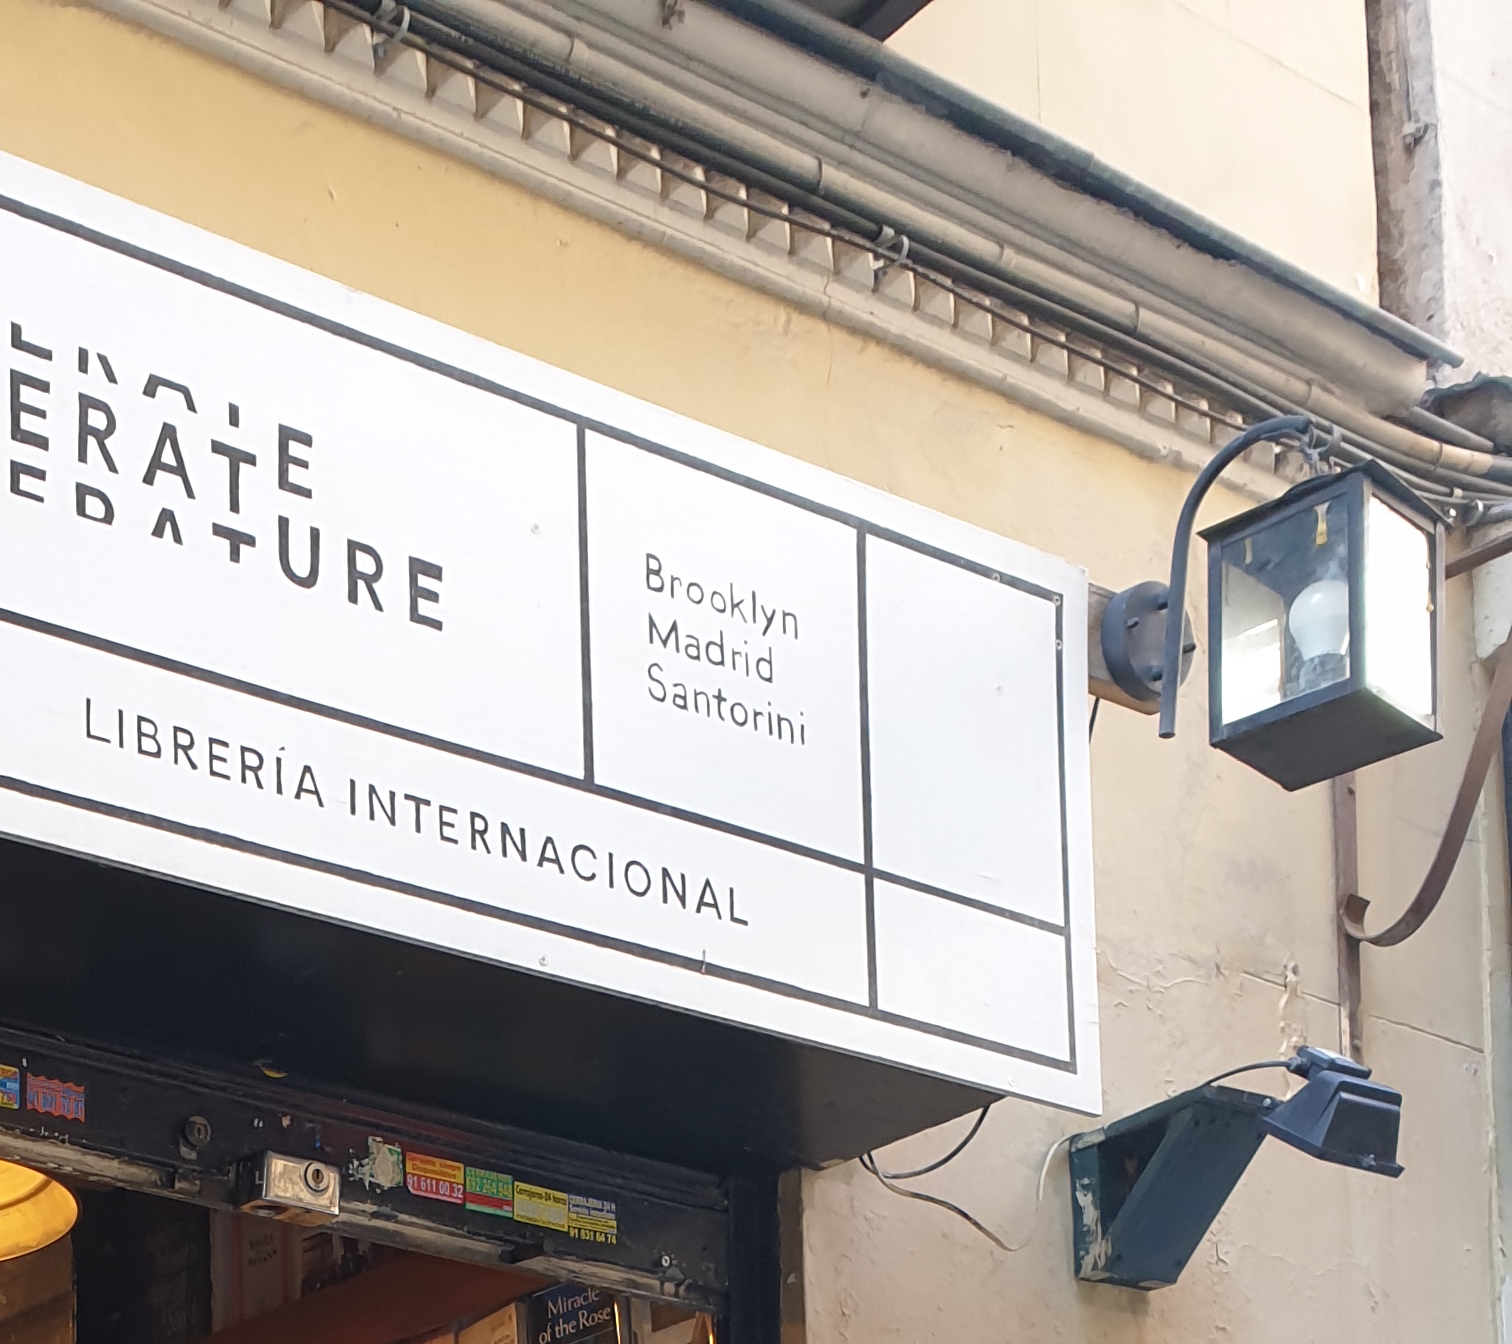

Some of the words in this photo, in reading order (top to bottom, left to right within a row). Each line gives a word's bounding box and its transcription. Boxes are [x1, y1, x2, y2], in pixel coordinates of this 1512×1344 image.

[644, 552, 800, 641] Brooklyn
[646, 612, 774, 684] Madrid
[645, 664, 809, 747] Santorini
[85, 697, 325, 808] LIBRERÍA
[349, 778, 750, 926] INTERNACIONAL
[406, 1174, 417, 1187] 91
[420, 1177, 436, 1192] 611
[439, 1181, 450, 1195] 00
[452, 1184, 464, 1199] 32
[569, 1227, 579, 1239] 91
[547, 1288, 600, 1320] Miracle
[554, 1316, 577, 1337] the
[579, 1306, 612, 1327] Rose
